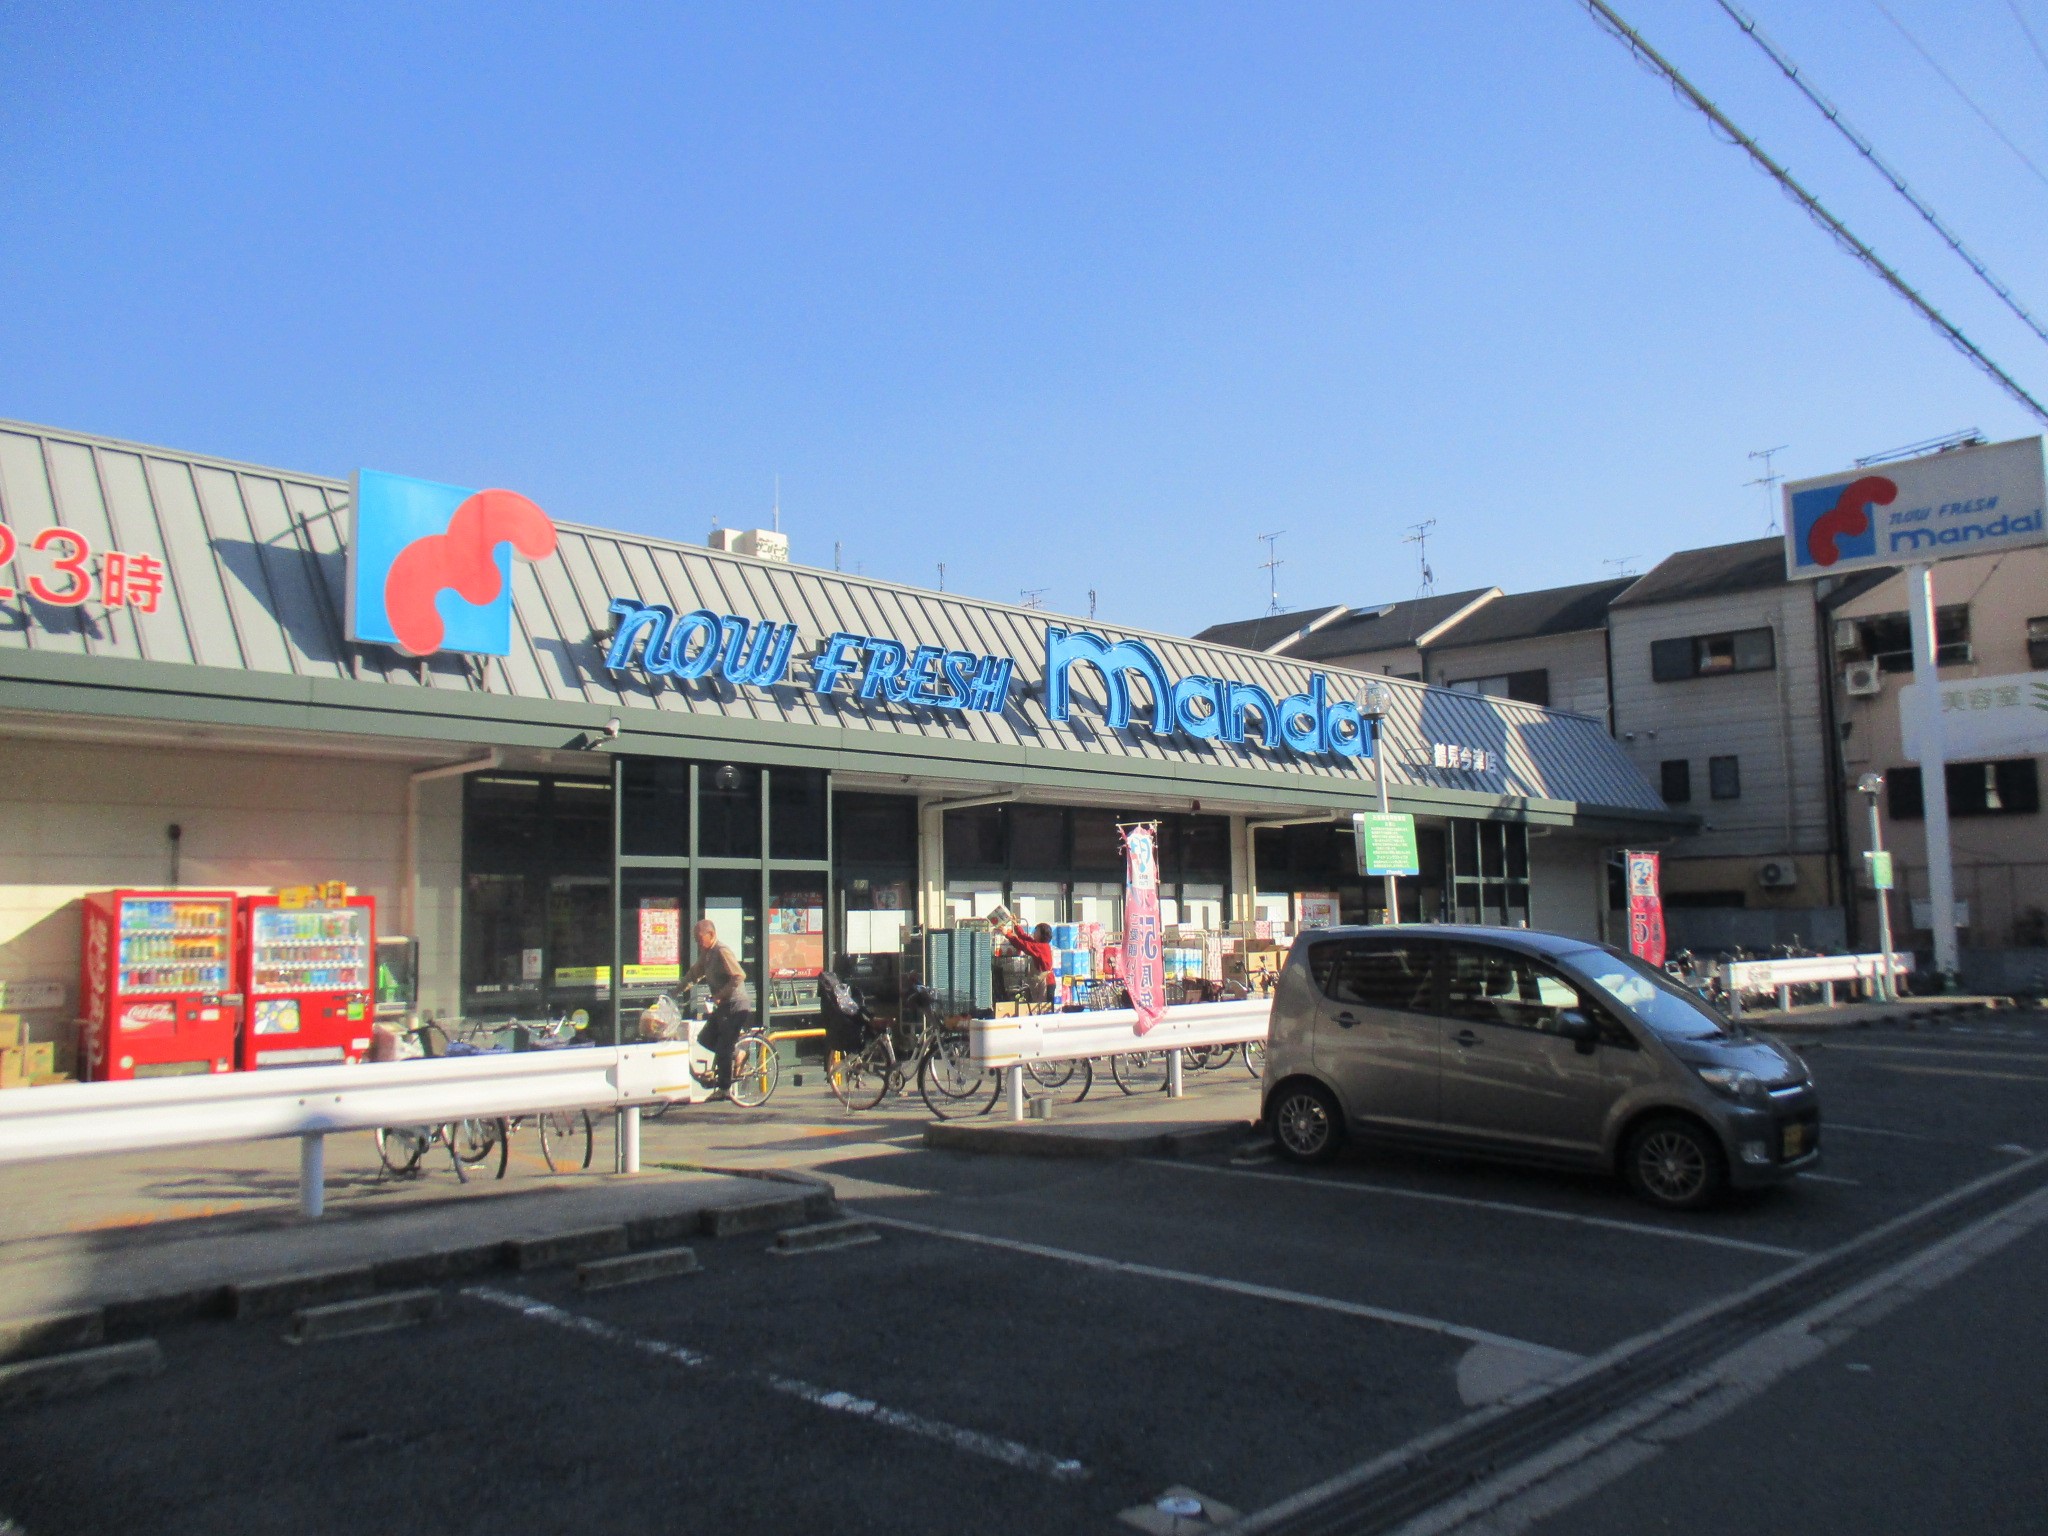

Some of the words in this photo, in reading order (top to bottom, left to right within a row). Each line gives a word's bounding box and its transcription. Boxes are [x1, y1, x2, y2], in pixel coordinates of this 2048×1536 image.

[0, 522, 164, 613] 3時
[1889, 508, 2043, 552] mandai
[813, 631, 1014, 713] FRESH
[1045, 626, 1383, 758] manda
